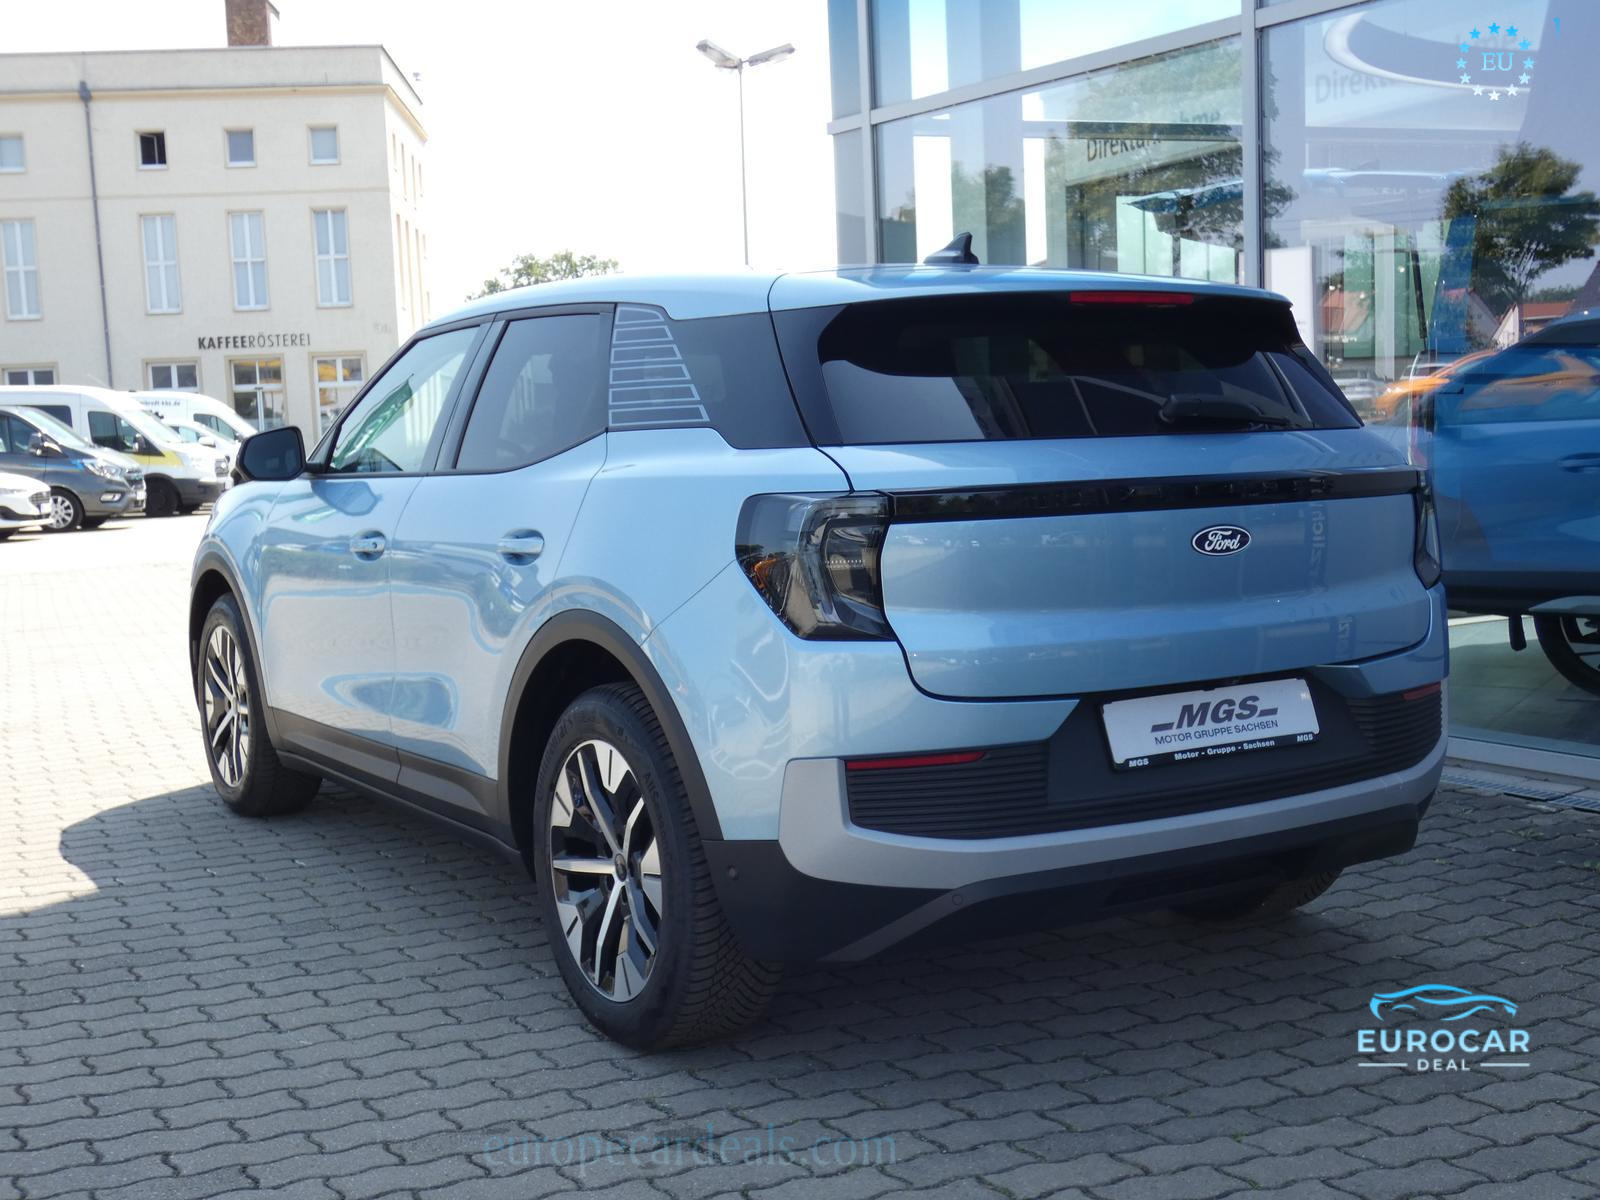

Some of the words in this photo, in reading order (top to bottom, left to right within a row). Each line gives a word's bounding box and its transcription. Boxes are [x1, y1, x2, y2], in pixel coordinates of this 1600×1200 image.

[198, 332, 311, 350] KAFFEERÖSTEREI
[1203, 529, 1241, 551] Ford
[1154, 732, 1193, 745] MOTOR
[1194, 726, 1234, 740] GRUPPE
[1234, 720, 1279, 734] SACHSEN
[1128, 758, 1149, 768] MGS
[1174, 750, 1200, 761] Motor
[1206, 745, 1236, 755] Gruppe
[1243, 740, 1275, 750] Sachsen
[1296, 733, 1314, 742] MGS
